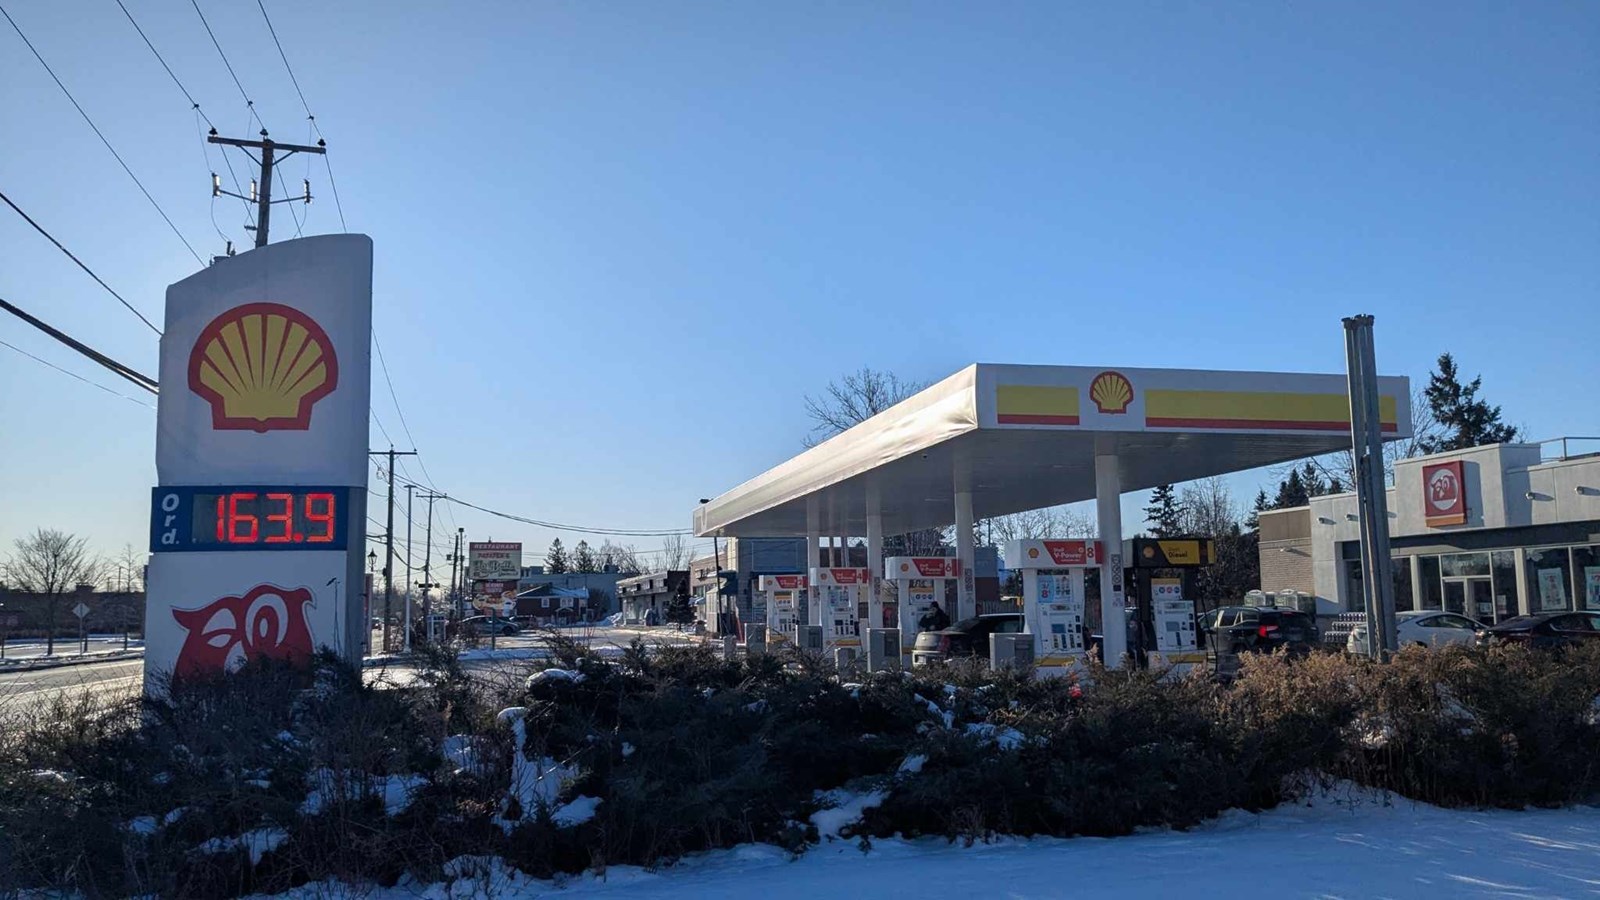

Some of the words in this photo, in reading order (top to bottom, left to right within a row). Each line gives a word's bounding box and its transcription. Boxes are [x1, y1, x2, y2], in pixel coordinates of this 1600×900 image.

[216, 492, 336, 543] 163.9
[1087, 547, 1094, 558] 8
[945, 563, 952, 572] 6
